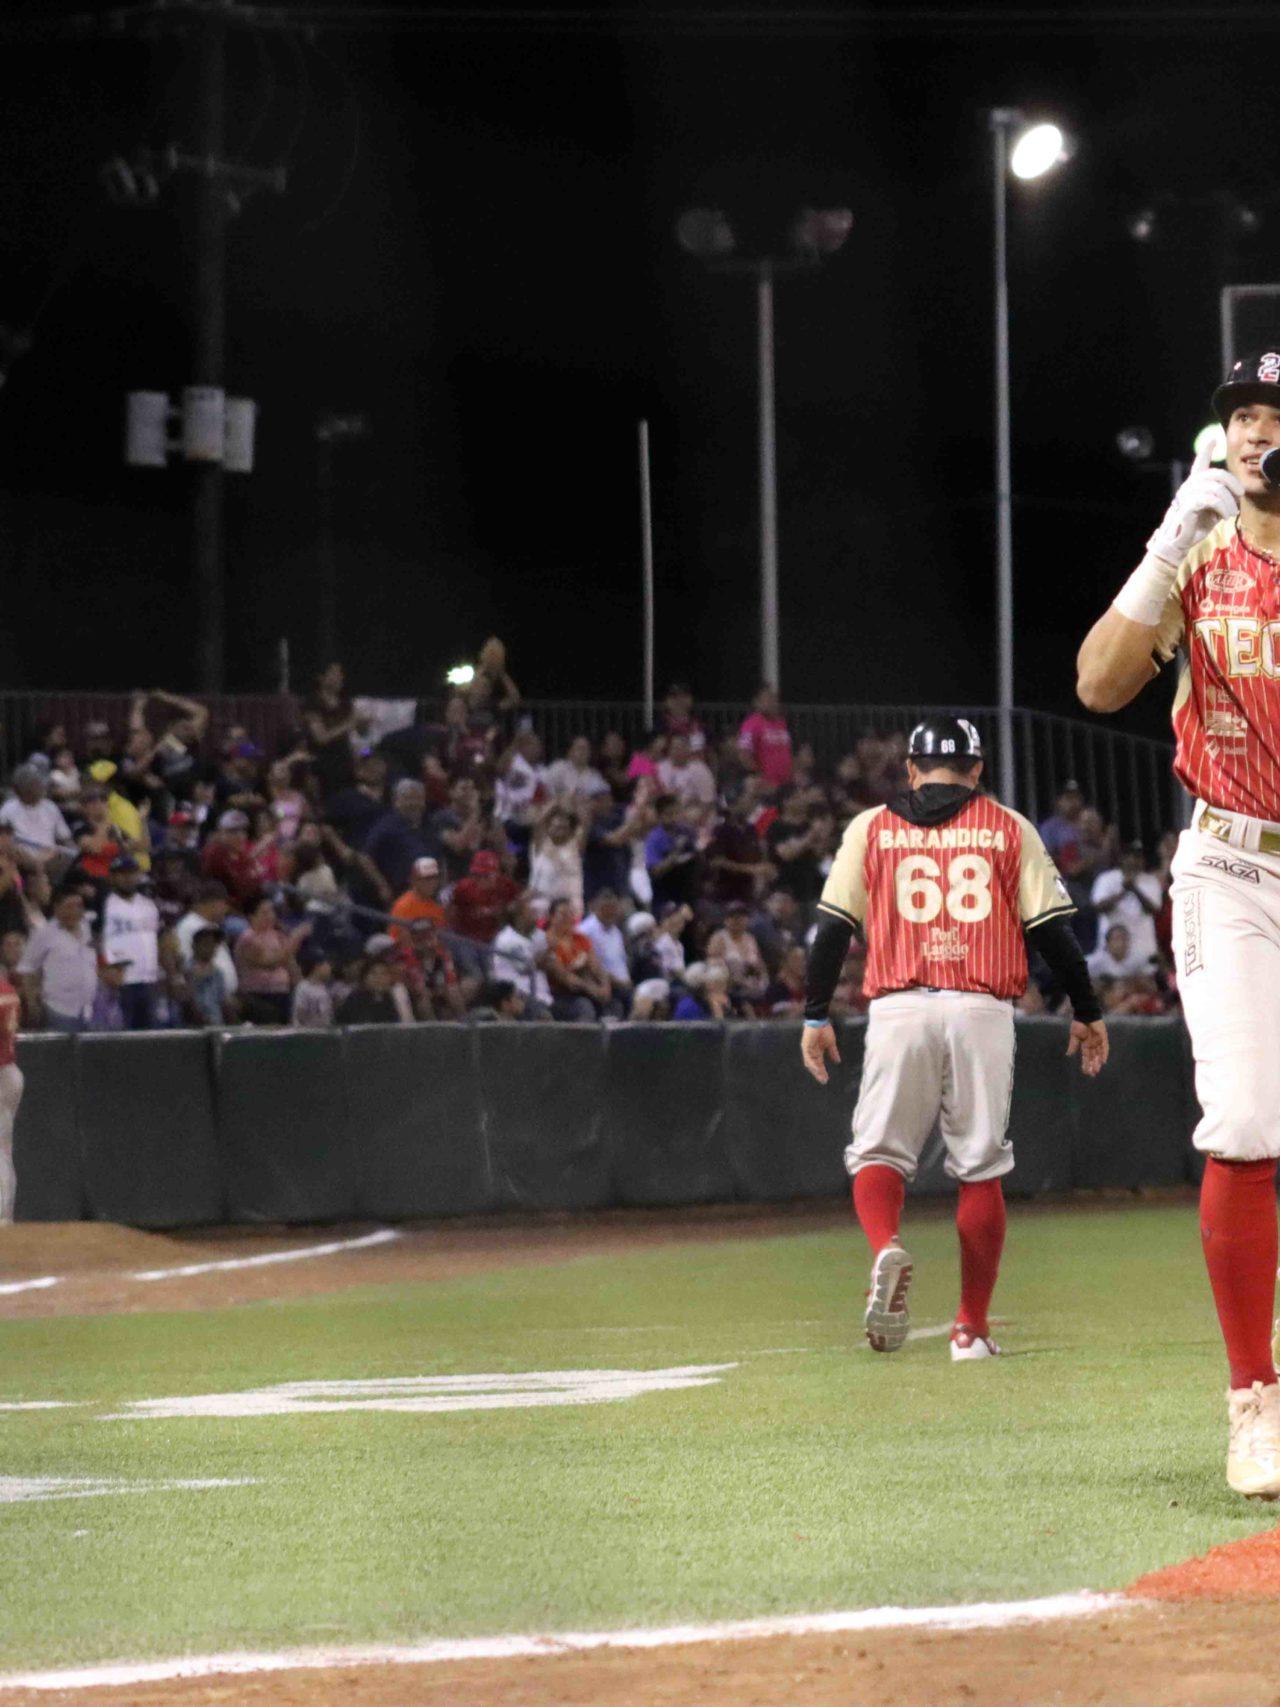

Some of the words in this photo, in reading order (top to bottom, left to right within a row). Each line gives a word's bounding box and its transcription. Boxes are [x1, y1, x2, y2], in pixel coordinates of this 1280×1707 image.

[940, 739, 956, 753] 68
[879, 828, 1005, 851] BARANDICA
[1197, 855, 1260, 885] SAGA
[896, 853, 993, 923] 68
